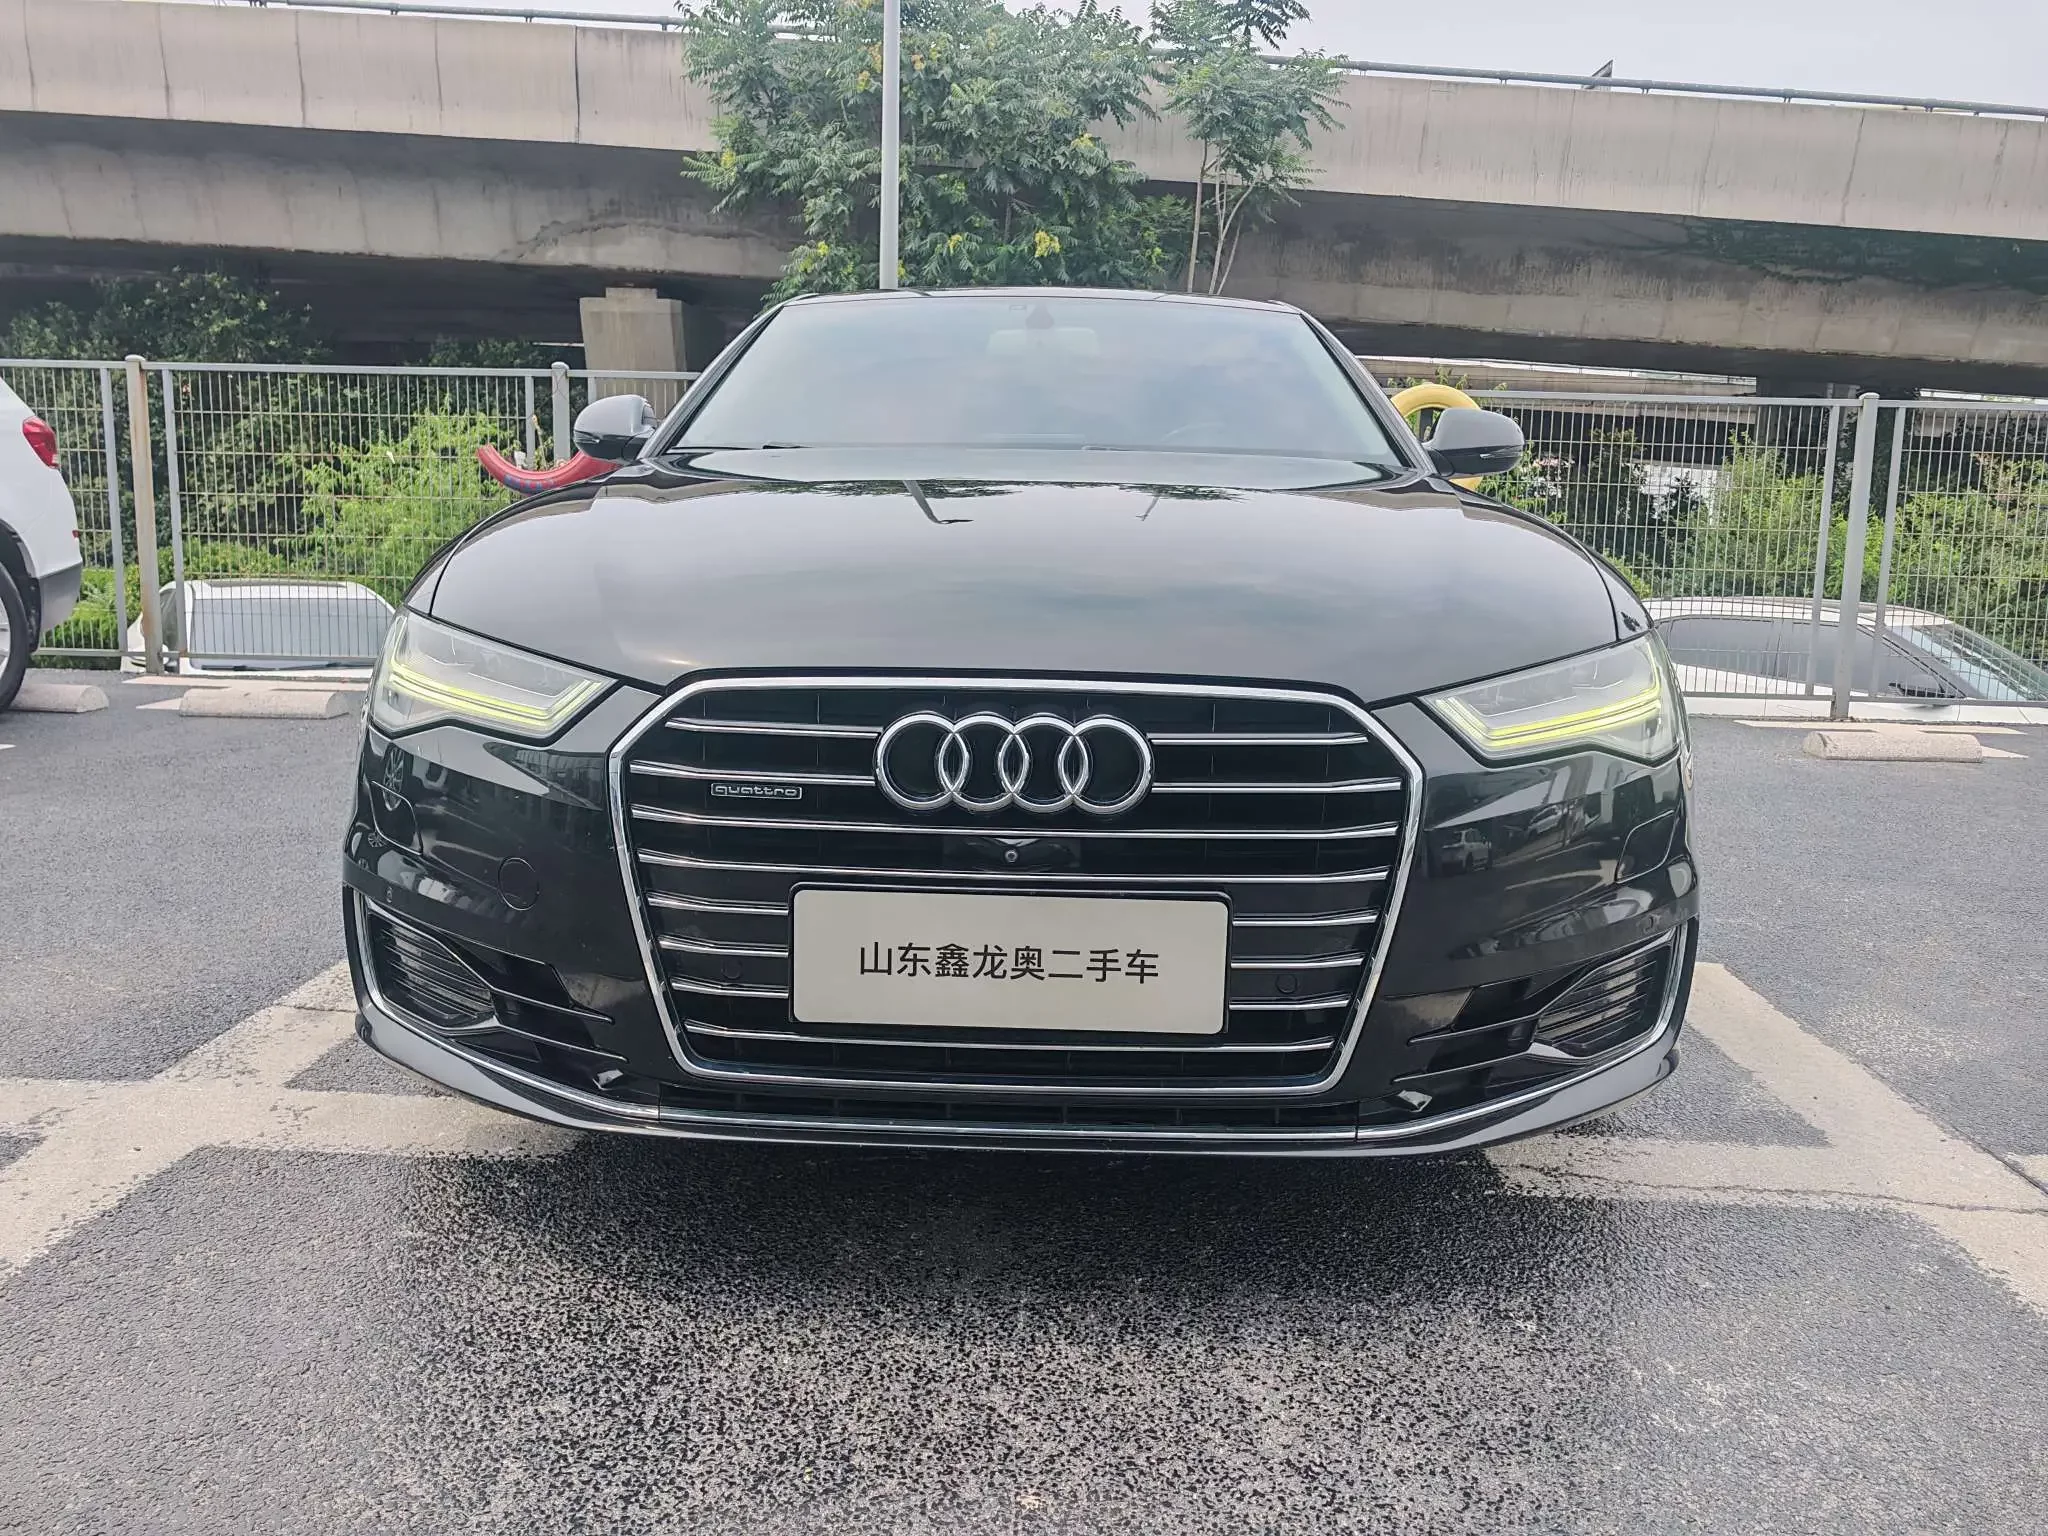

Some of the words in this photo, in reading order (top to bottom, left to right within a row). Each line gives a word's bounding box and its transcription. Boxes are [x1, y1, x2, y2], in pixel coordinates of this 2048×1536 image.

[715, 785, 798, 796] quattro
[859, 941, 1160, 985] 山东鑫龙奥二手车
